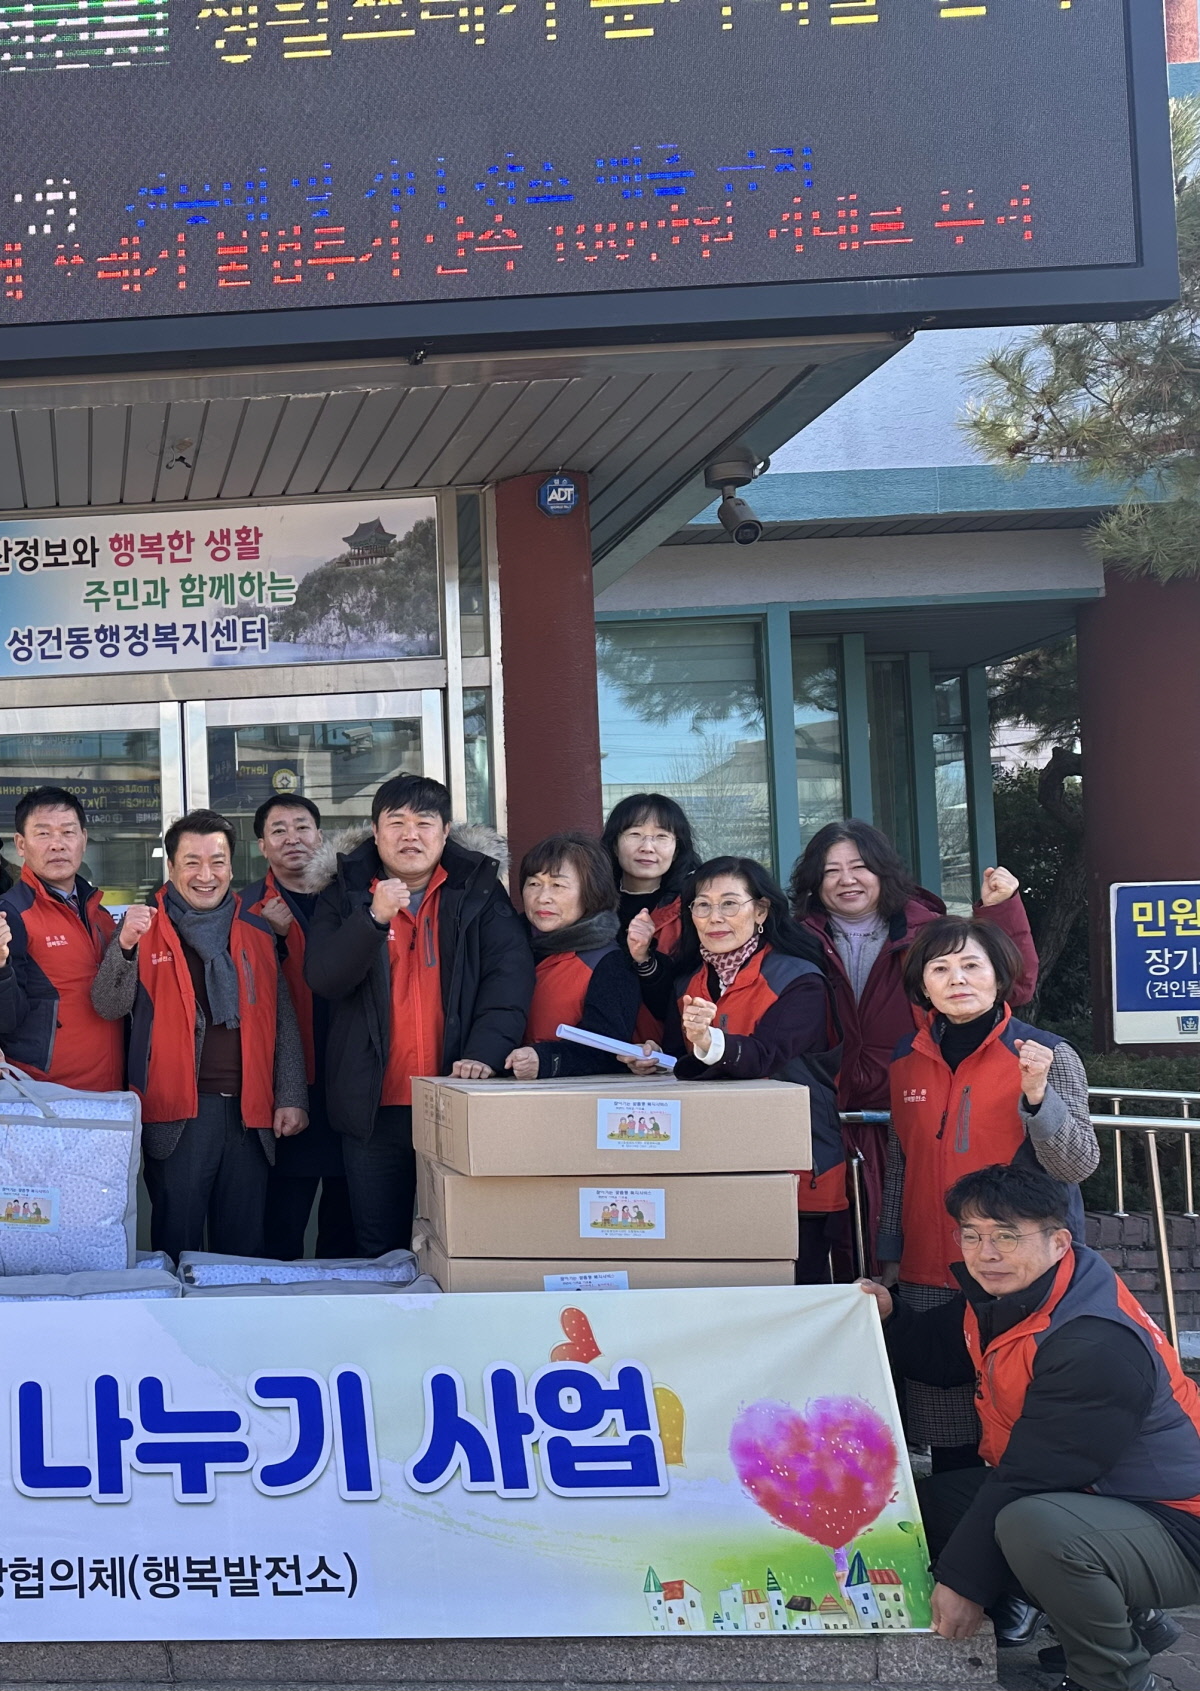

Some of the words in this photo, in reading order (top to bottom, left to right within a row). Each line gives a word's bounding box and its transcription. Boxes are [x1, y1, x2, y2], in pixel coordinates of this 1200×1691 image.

[547, 487, 574, 502] ADT
[108, 529, 196, 567] 행복한
[204, 525, 264, 561] 생활
[83, 577, 171, 613] 주민과
[179, 571, 297, 608] 함께하는
[6, 616, 269, 664] 성건동행정복지센터
[1145, 947, 1200, 976] 장기
[16, 1370, 377, 1497] 나누기
[409, 1363, 663, 1494] 사업
